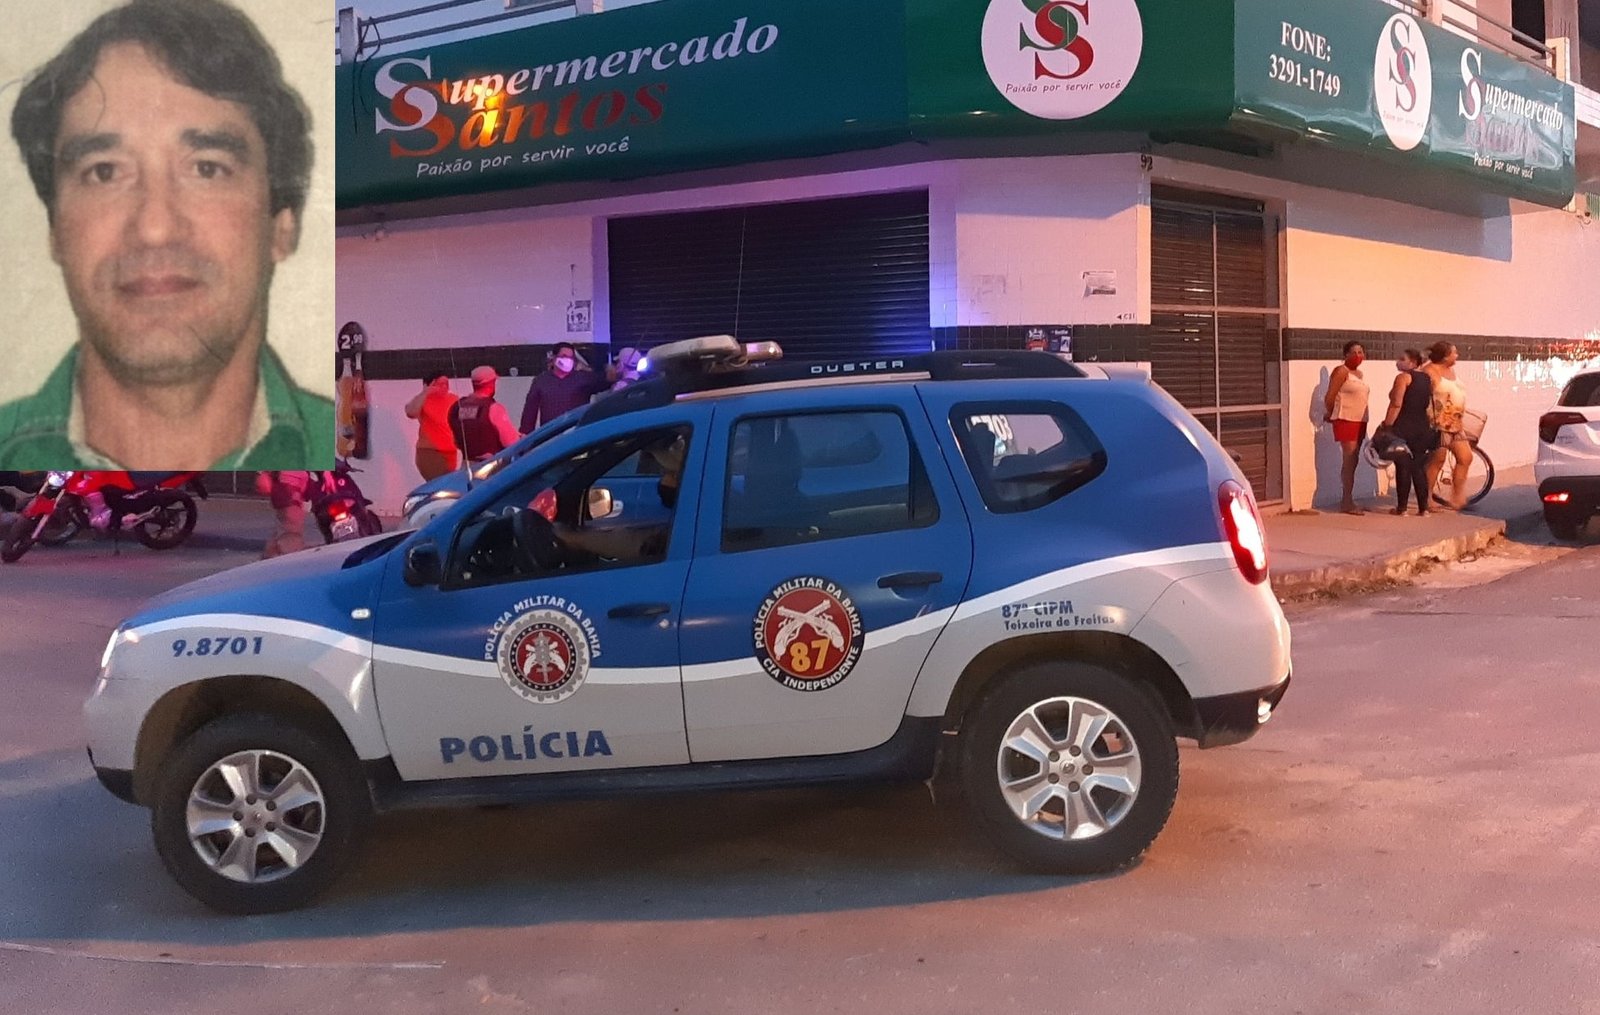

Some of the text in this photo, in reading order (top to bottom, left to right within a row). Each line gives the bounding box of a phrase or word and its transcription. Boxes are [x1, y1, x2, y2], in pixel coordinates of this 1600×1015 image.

[1281, 21, 1332, 63] FONE:
[375, 17, 779, 134] Supermercado
[1005, 79, 1122, 94] Paixão por servir você
[1269, 54, 1341, 97] 3291-1749
[1459, 47, 1563, 130] Supermercado
[390, 83, 669, 158] Santos
[417, 136, 630, 178] Paixão por servir você
[810, 360, 904, 374] DUSTER
[484, 595, 602, 660] POLÍCIA MILITAR DA BAHIA
[754, 577, 861, 649] POLÍCIA MILITAR DA BAHIA
[1004, 614, 1115, 631] Teixeira de Freitas
[172, 636, 264, 657] 9.8701
[790, 638, 831, 672] 87
[763, 646, 860, 690] CIA INDEPENDENTE
[440, 725, 612, 764] POLÍCIA
